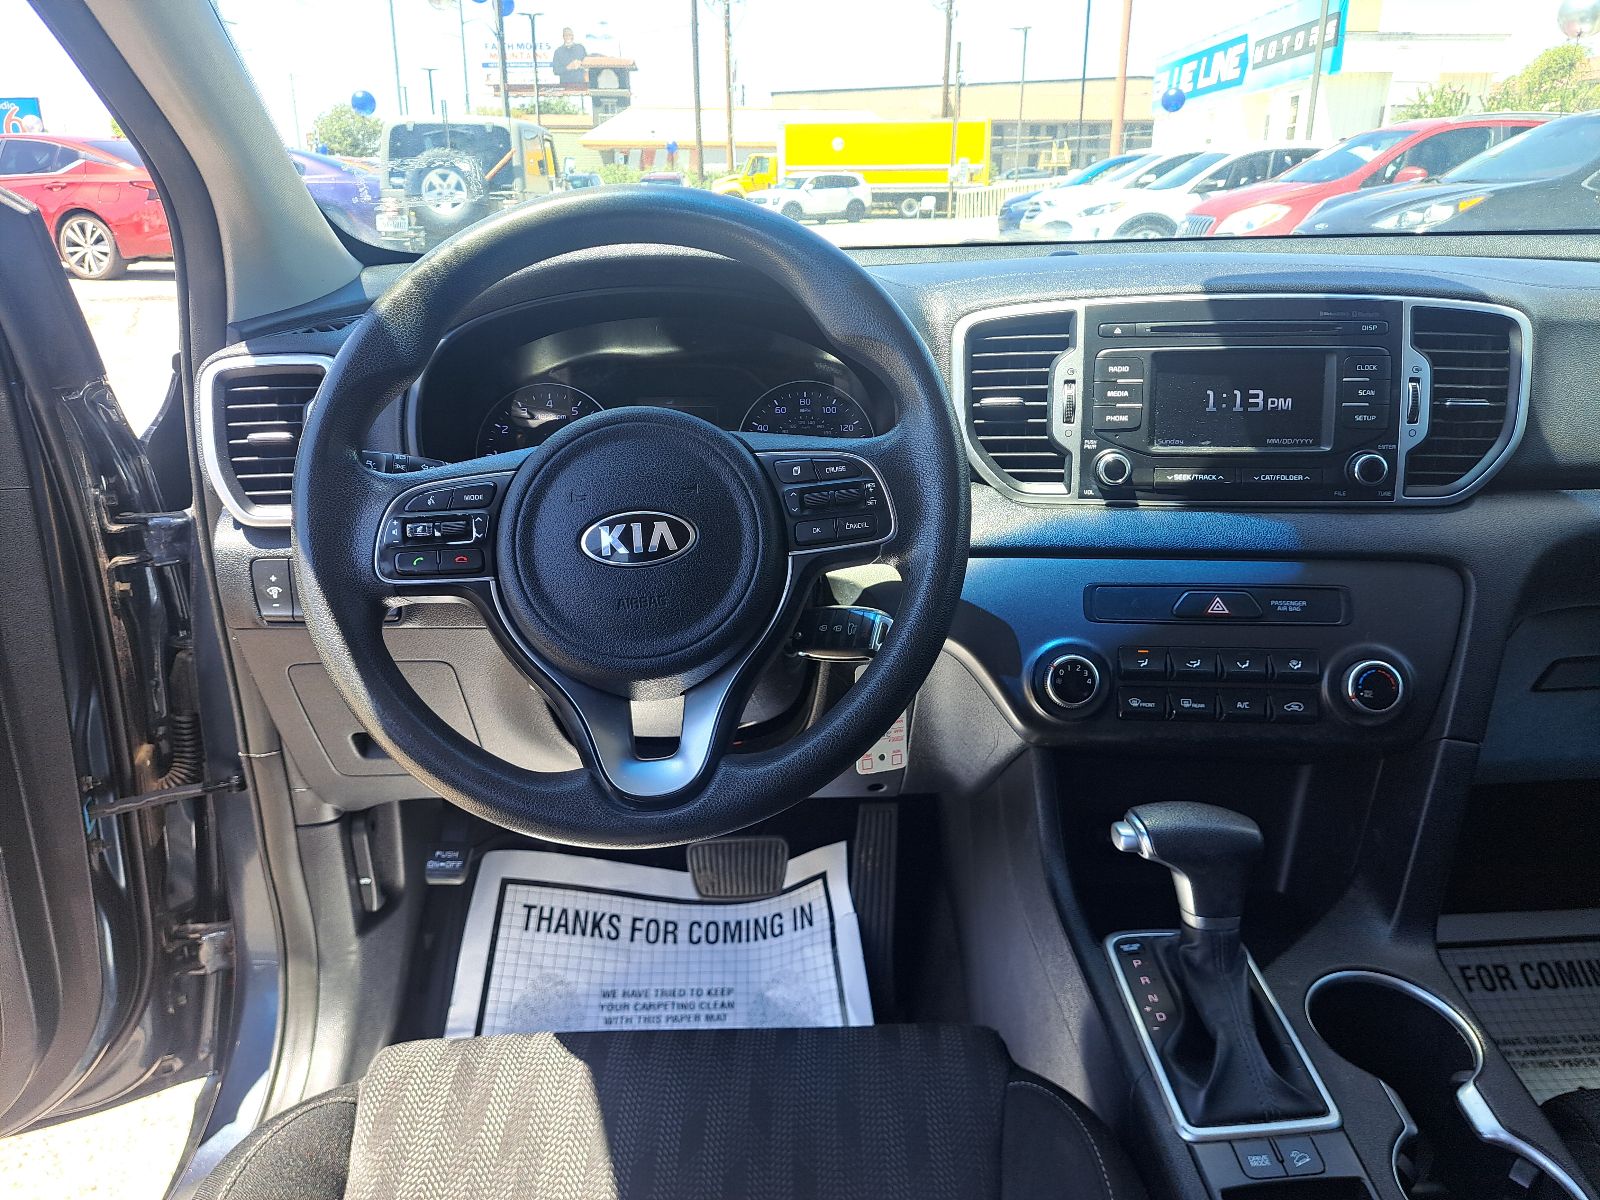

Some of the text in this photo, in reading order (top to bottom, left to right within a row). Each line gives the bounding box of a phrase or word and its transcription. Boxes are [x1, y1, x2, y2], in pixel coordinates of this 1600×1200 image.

[1252, 18, 1338, 65] MOTORS
[1108, 365, 1130, 373] RADIO
[1106, 390, 1129, 398] MEDIA
[546, 399, 553, 408] 4
[799, 398, 811, 406] 80
[1204, 389, 1293, 412] 1:13 PM
[520, 407, 528, 416] 3
[571, 406, 579, 416] 5
[774, 406, 787, 414] 60
[822, 406, 837, 414] 100
[1105, 414, 1129, 422] PHONE
[1354, 414, 1377, 422] SETUP
[501, 425, 509, 434] 2
[757, 424, 769, 432] 40
[840, 424, 854, 432] 120
[1157, 438, 1185, 446] Sunday
[1266, 437, 1314, 445] MM/DD/YYYY
[825, 465, 847, 474] CRUISE
[1260, 474, 1304, 482] CAT/FOLDER
[845, 521, 870, 530] CANCEL
[598, 520, 679, 557] KIA
[1058, 668, 1065, 676] 0
[1075, 664, 1082, 672] 2
[1083, 669, 1089, 677] 3
[1236, 701, 1250, 709] A/C
[523, 902, 814, 945] THANKS FOR COMING IN
[1132, 959, 1142, 968] P
[1457, 958, 1600, 993] FOR COMIN
[1140, 976, 1151, 985] R
[601, 986, 735, 998] WE HAVE TRIED TO KEEP
[1147, 993, 1159, 1003] N
[600, 1001, 735, 1012] YOUR CARPETING CLEAN
[604, 1013, 727, 1025] WITH THIS PAPER MAT
[1155, 1012, 1167, 1022] D
